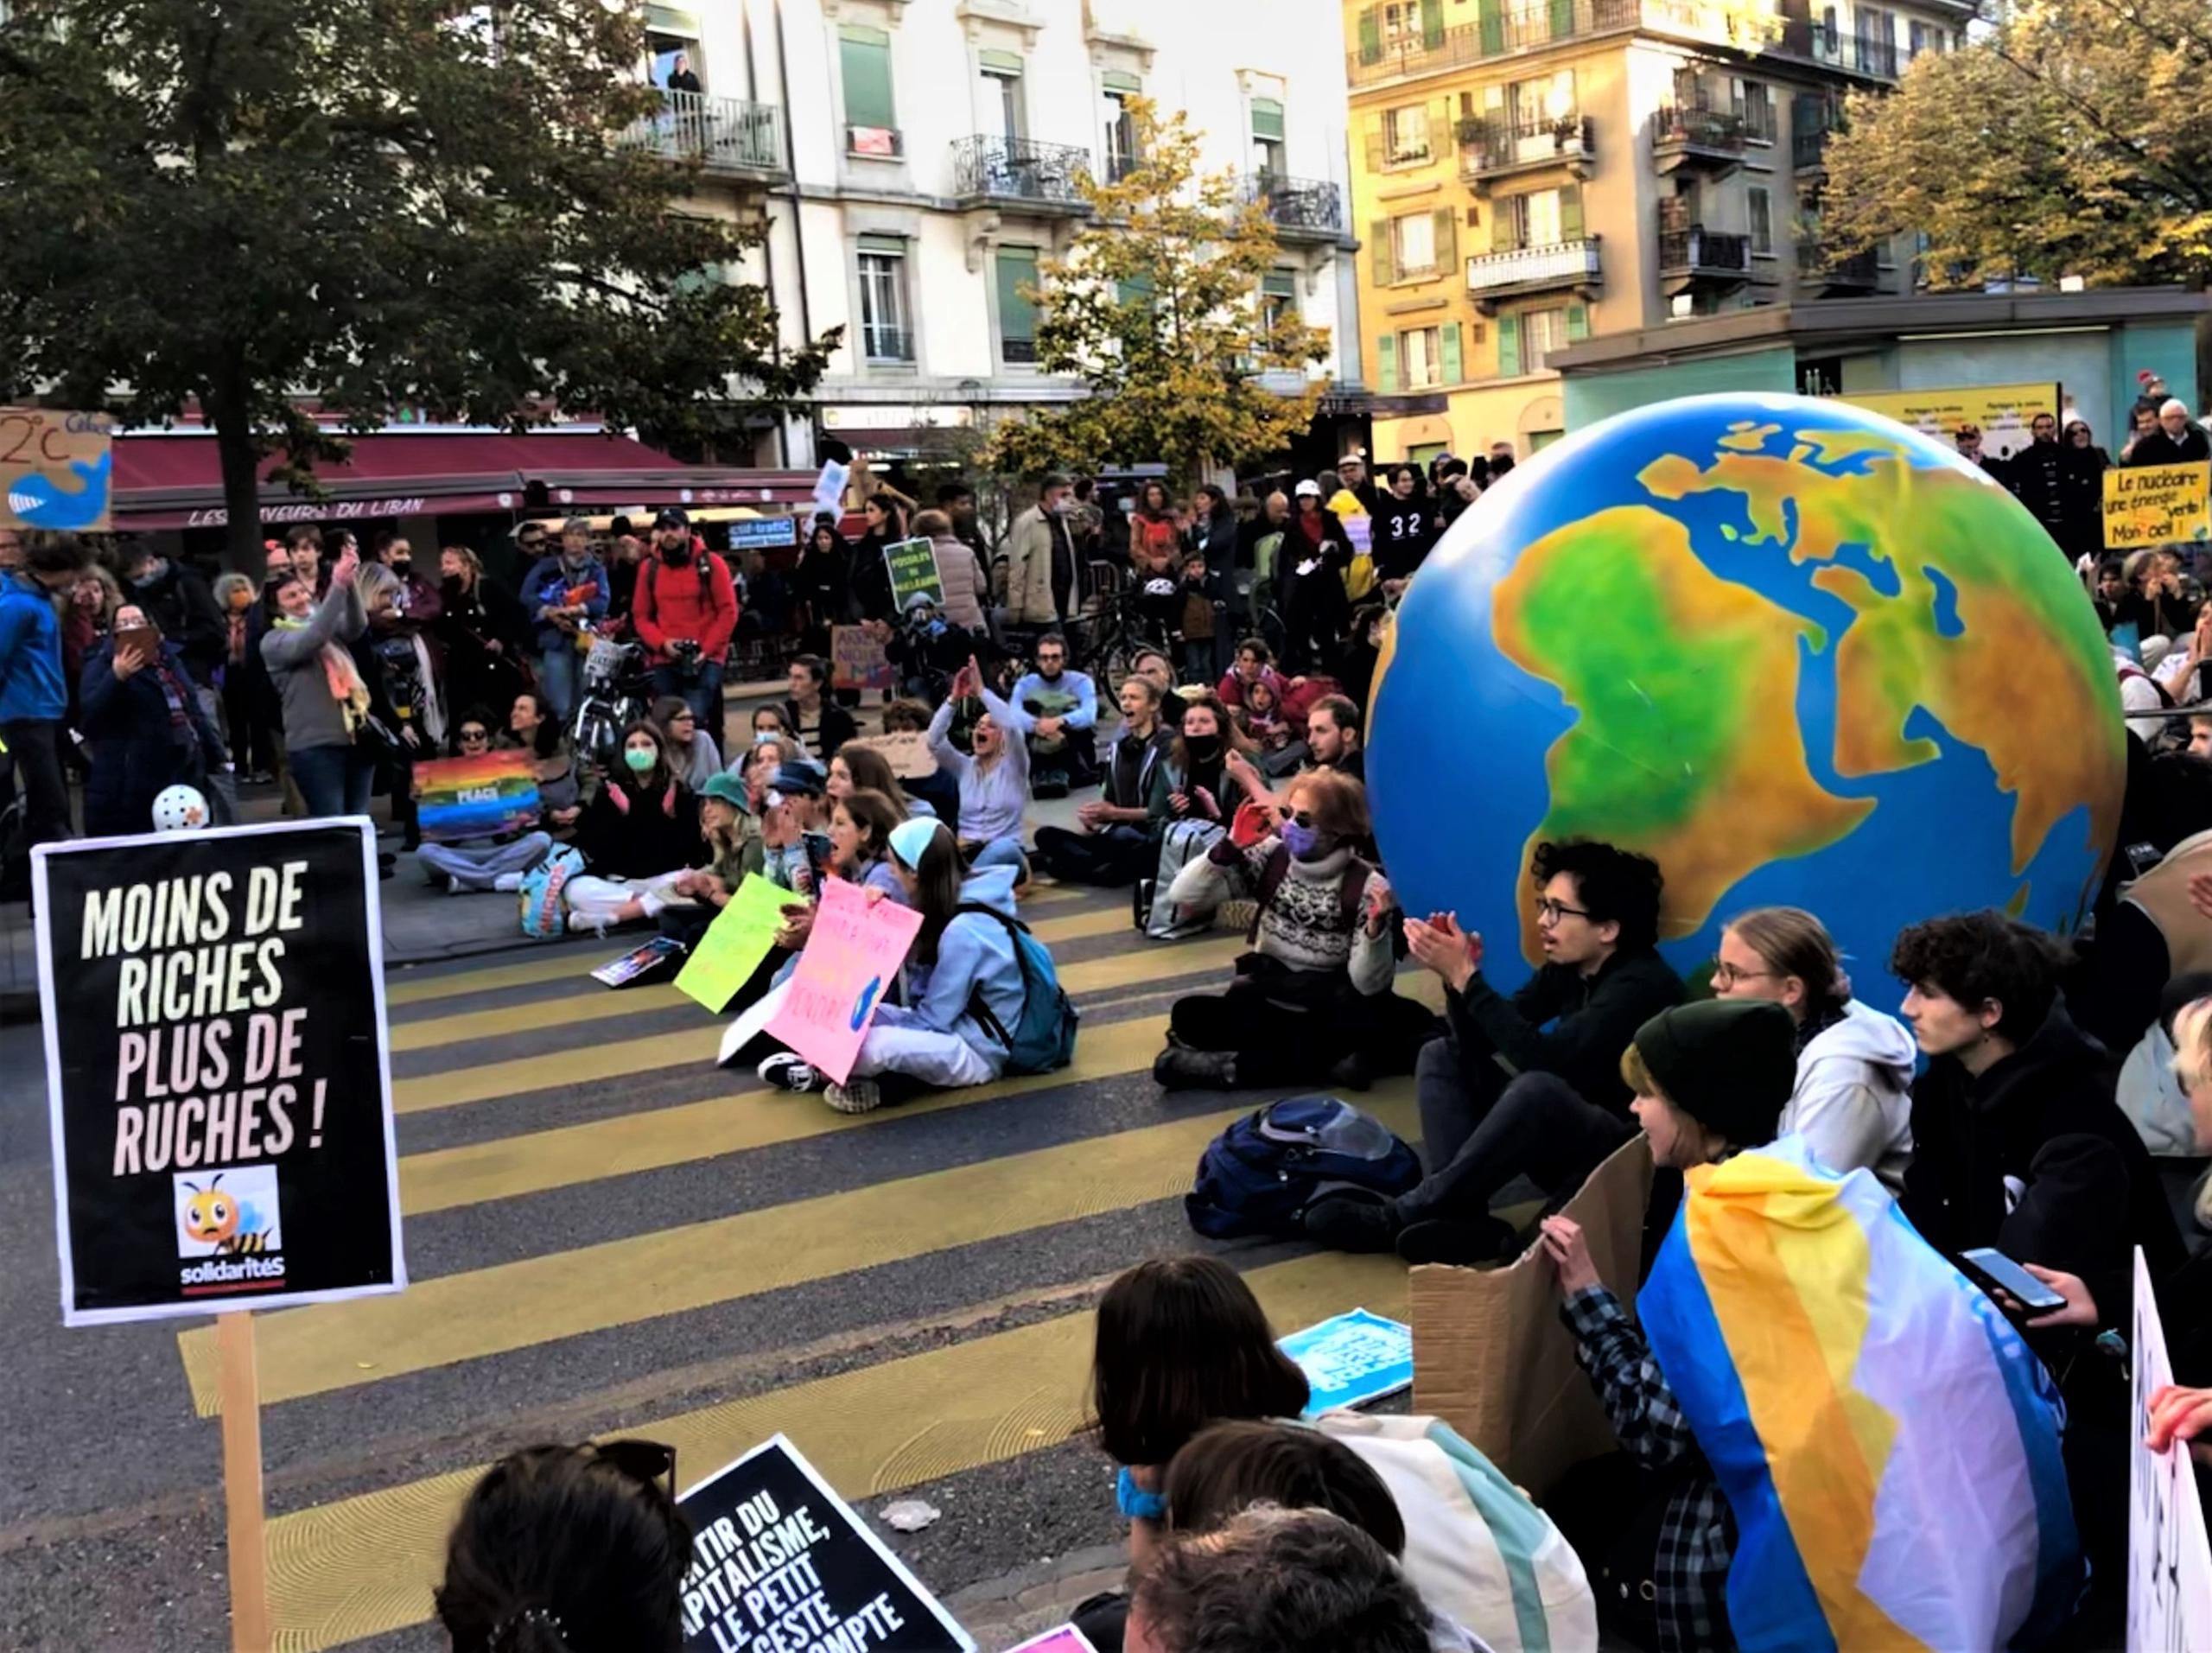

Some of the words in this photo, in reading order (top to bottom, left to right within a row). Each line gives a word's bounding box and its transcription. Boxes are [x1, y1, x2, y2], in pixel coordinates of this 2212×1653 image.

[188, 508, 228, 526] LES
[335, 500, 364, 518] DU
[370, 497, 425, 516] LIBAN
[2117, 472, 2133, 493] Le
[457, 786, 499, 805] PEACE
[81, 871, 233, 960] MOINS
[245, 861, 308, 937] DE
[117, 938, 285, 1028] RICHES
[116, 1019, 232, 1103] PLUS
[244, 1008, 308, 1084] DE
[113, 1083, 297, 1177] RUCHES
[309, 1078, 327, 1149] !
[736, 1489, 780, 1538] DU
[709, 1605, 752, 1653] LE
[743, 1552, 822, 1629] PETIT
